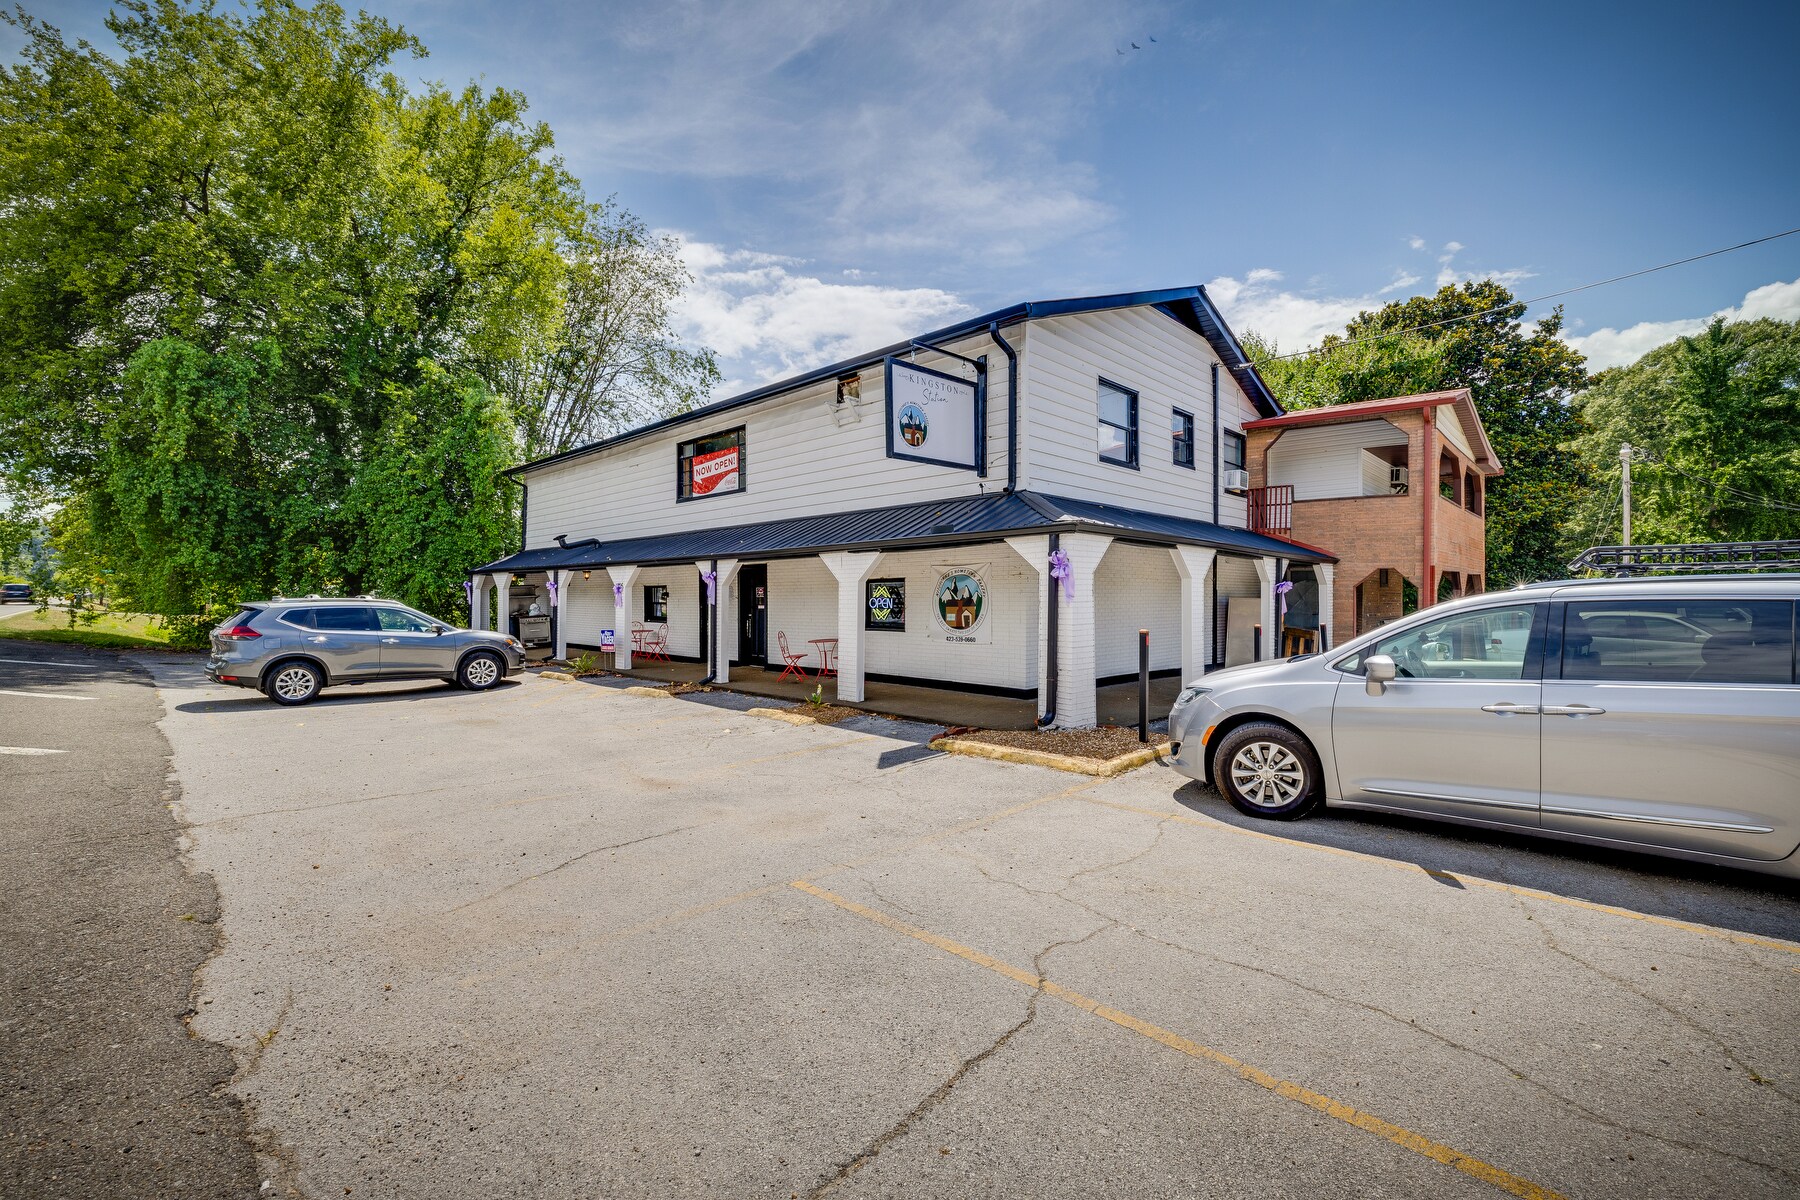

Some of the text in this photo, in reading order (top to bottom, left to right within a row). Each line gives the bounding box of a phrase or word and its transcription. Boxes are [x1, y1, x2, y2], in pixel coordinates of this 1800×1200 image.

[909, 374, 959, 394] KINGSTON
[921, 388, 949, 406] Station
[695, 456, 736, 477] NOW OPEN!
[869, 597, 893, 609] OPEN
